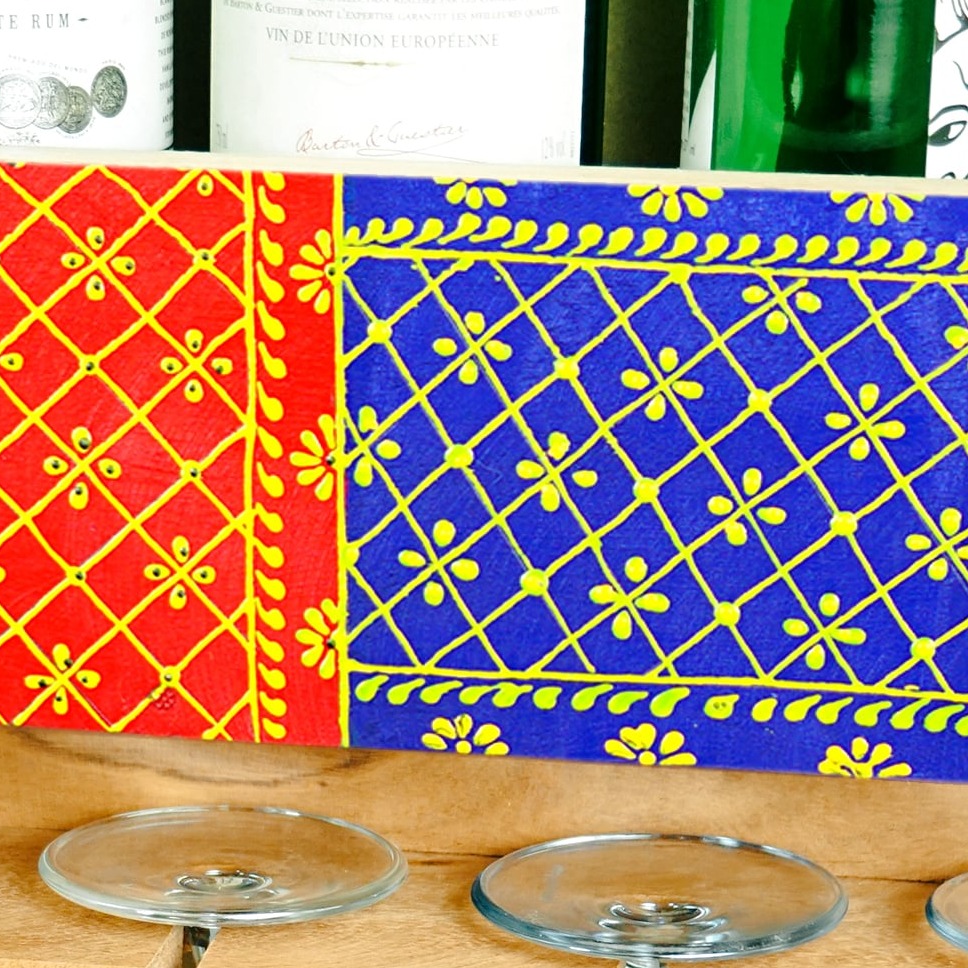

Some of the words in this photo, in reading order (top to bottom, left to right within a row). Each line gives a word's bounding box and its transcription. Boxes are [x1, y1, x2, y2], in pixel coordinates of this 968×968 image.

[32, 13, 71, 29] RUM
[265, 26, 289, 42] VIN
[293, 29, 313, 44] DE
[318, 31, 384, 48] L'UNION
[391, 32, 500, 48] EUROPÉENNE
